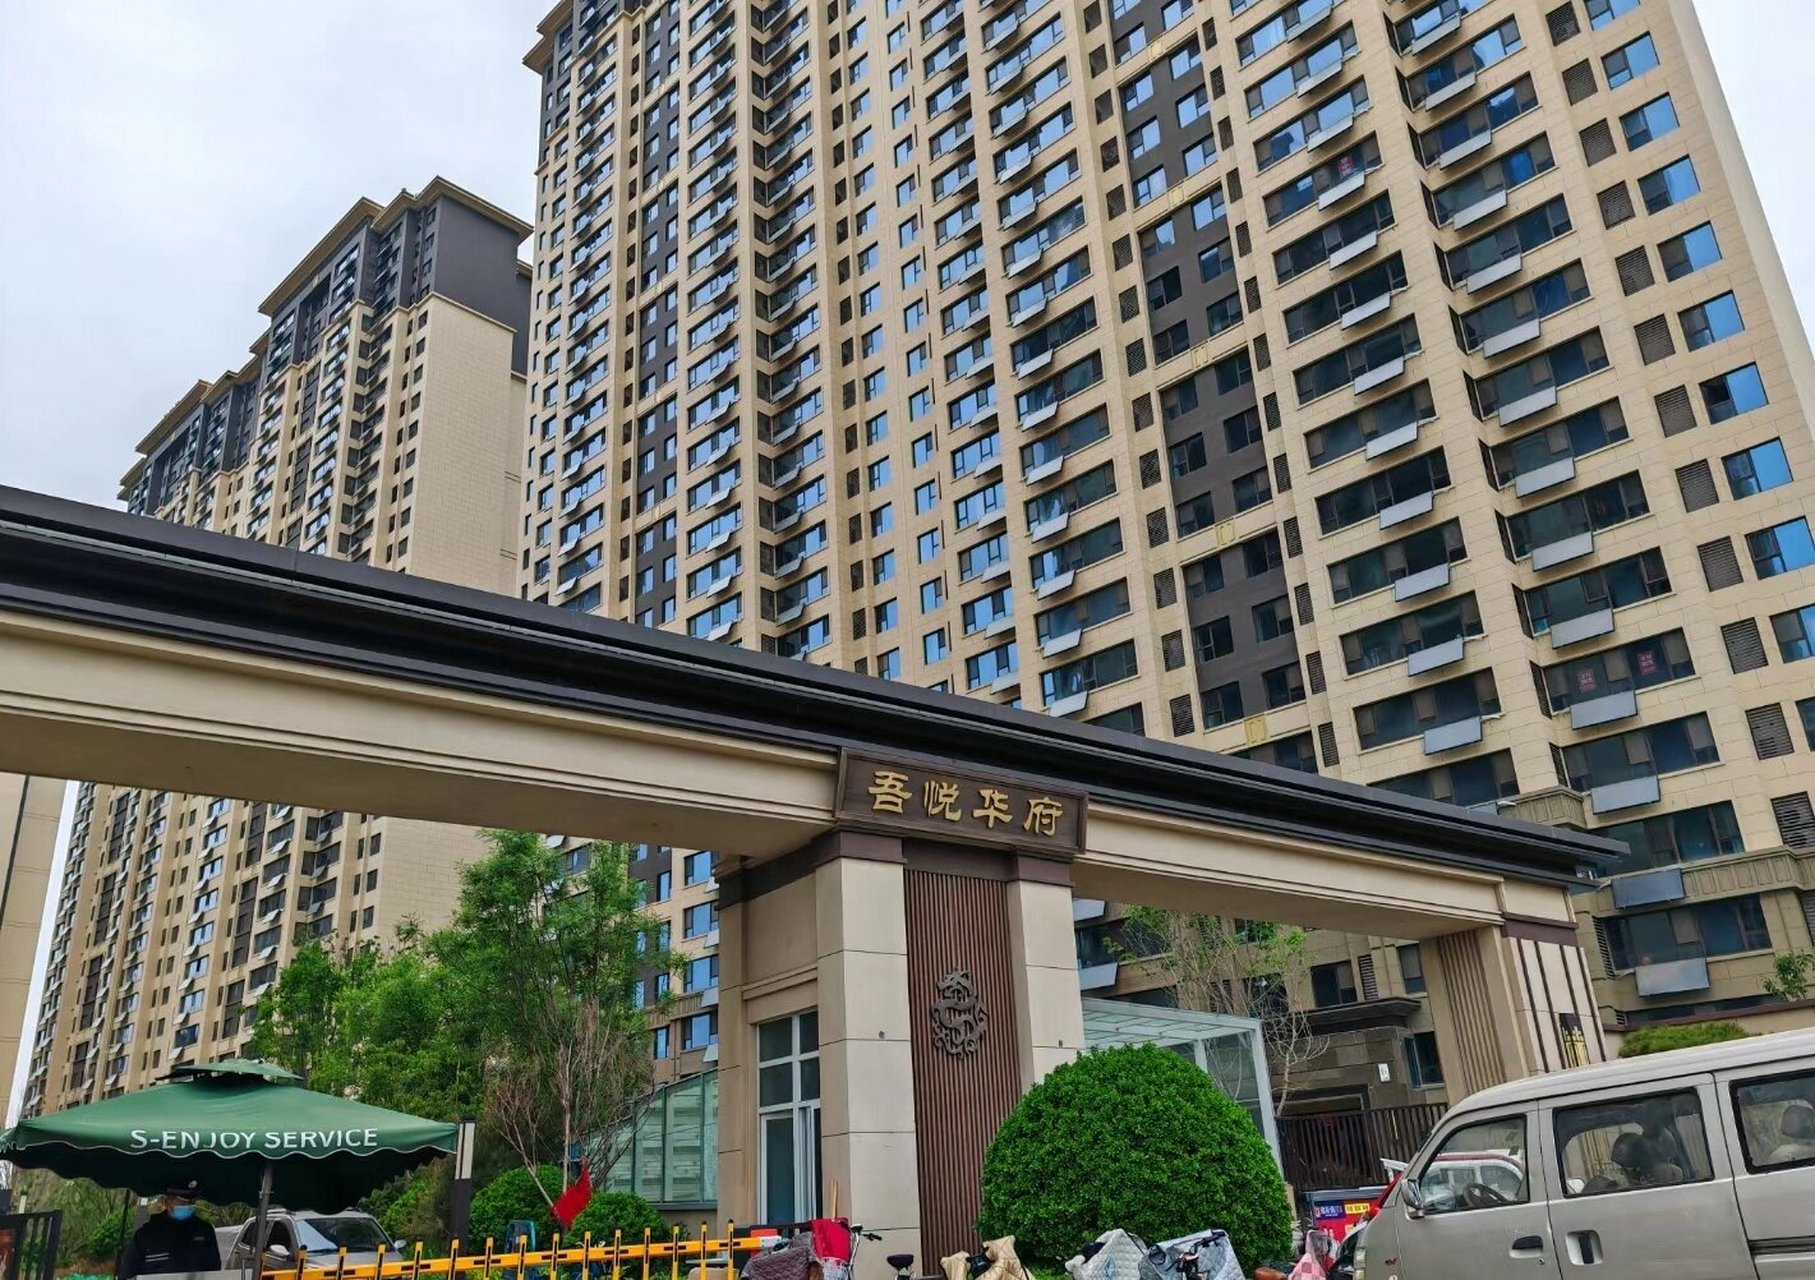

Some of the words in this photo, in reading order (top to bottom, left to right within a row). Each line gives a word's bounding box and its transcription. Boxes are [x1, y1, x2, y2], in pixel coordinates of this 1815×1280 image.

[868, 771, 1063, 836] 吾悦华府
[130, 1130, 255, 1149] S-ENJOY
[264, 1128, 378, 1148] SERVICE
